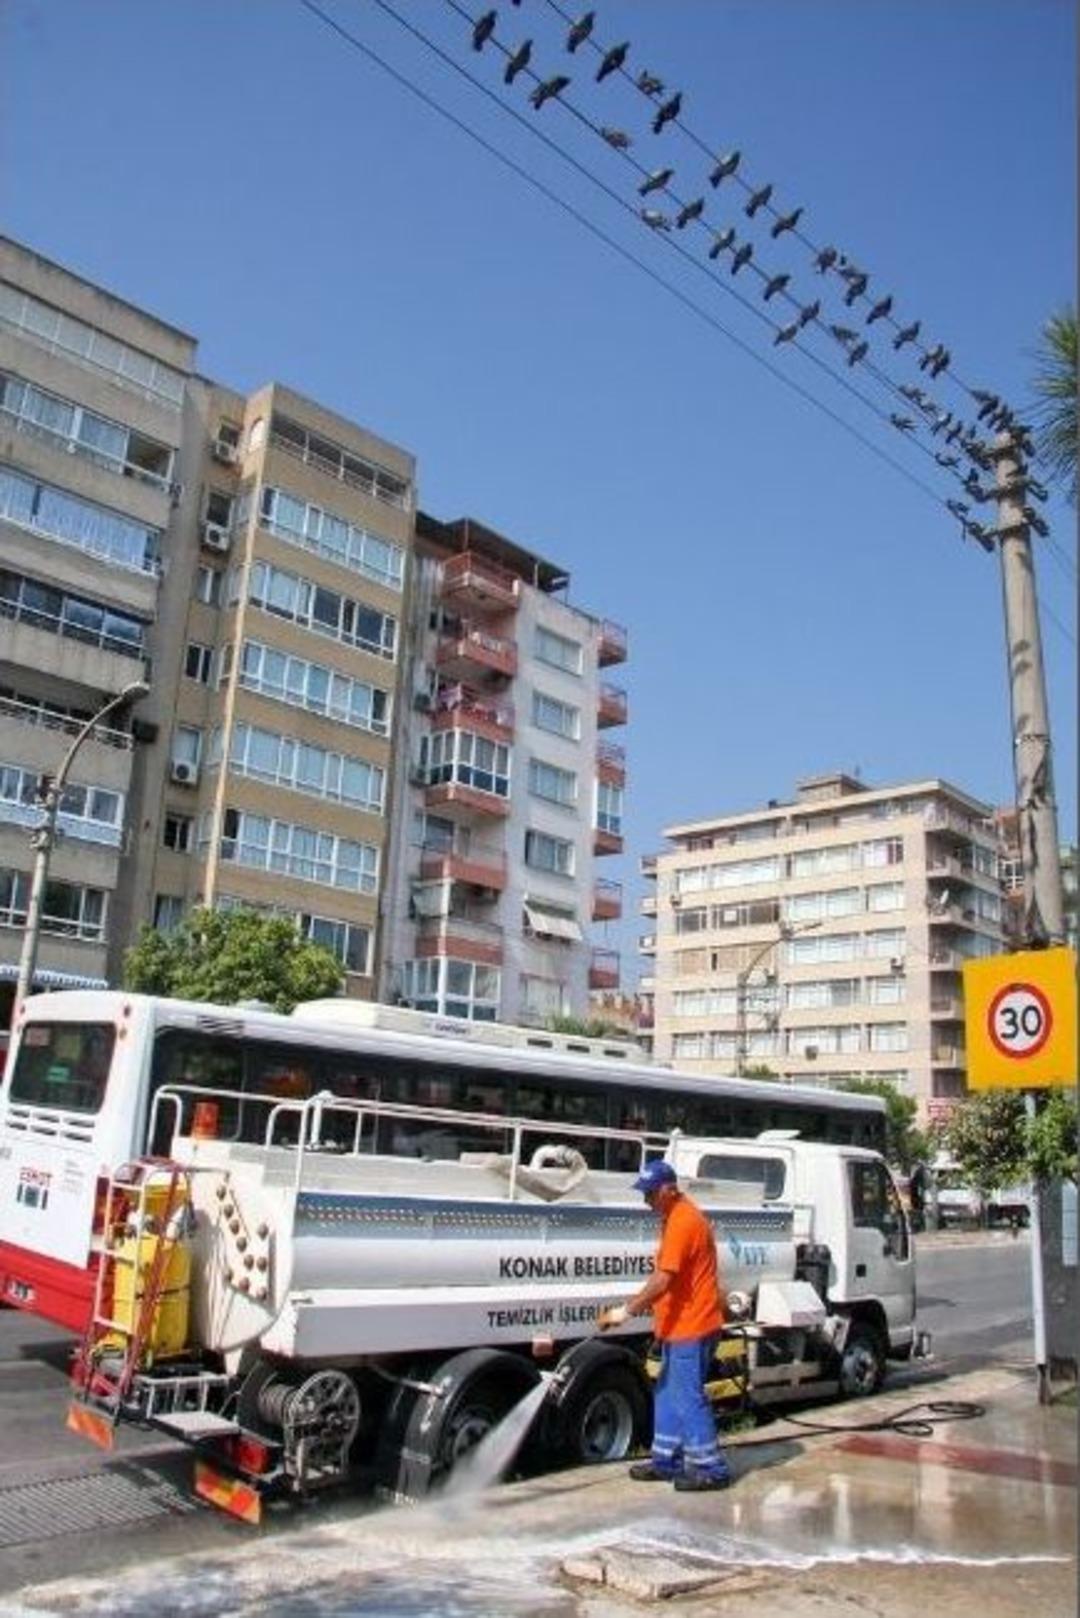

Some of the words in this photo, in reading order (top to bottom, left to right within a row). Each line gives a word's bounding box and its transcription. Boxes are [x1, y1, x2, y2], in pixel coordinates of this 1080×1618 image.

[1000, 1005, 1042, 1040] 30
[499, 1255, 567, 1279] KONAK
[574, 1251, 656, 1276] BELEDİYES
[487, 1306, 554, 1328] TEMİZLİK
